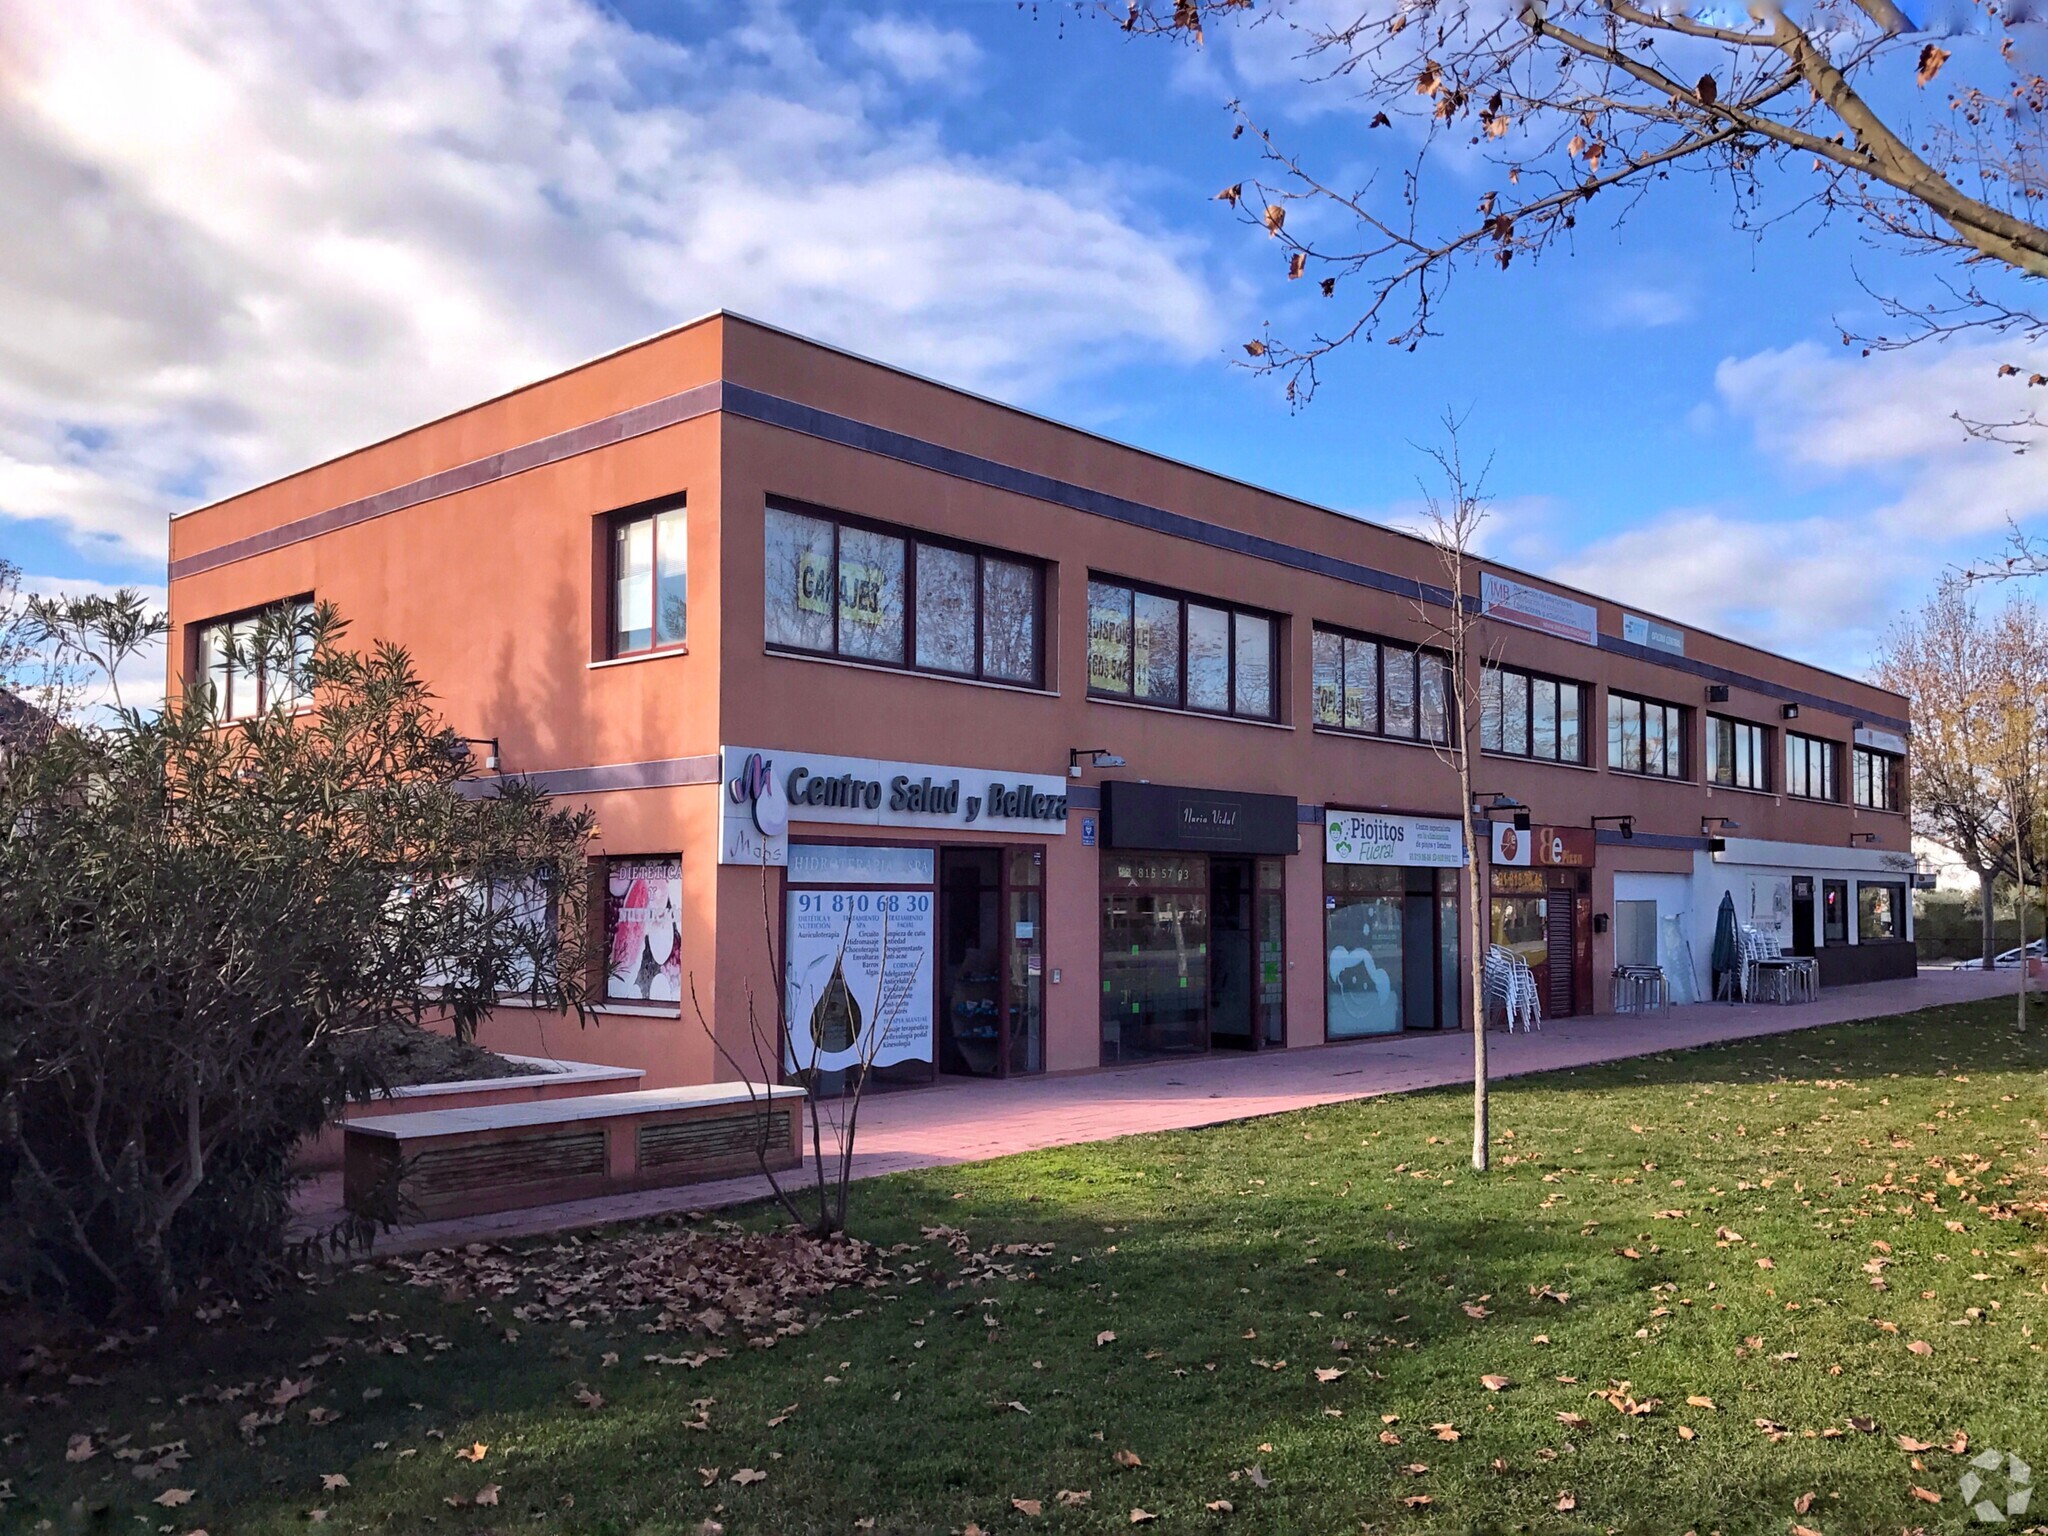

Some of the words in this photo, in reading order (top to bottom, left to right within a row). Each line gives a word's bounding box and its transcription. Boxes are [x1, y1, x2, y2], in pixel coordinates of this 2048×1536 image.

[1091, 618, 1148, 650] DISPONLE
[787, 767, 882, 809] Centro
[890, 775, 959, 812] Salud
[965, 797, 982, 822] y
[988, 783, 1069, 820] Belleza
[1183, 808, 1208, 823] Nuria
[1212, 810, 1236, 825] Vidal
[1351, 818, 1404, 844] Piojitos
[1359, 840, 1396, 861] Fuera!
[618, 862, 682, 880] DIETÉTICA
[1138, 868, 1156, 878] 815
[1161, 869, 1173, 879] 57
[799, 894, 822, 912] 91
[832, 894, 869, 912] 810
[877, 895, 899, 912] 68
[906, 895, 929, 912] 30
[798, 931, 840, 939] Auriculoterapia
